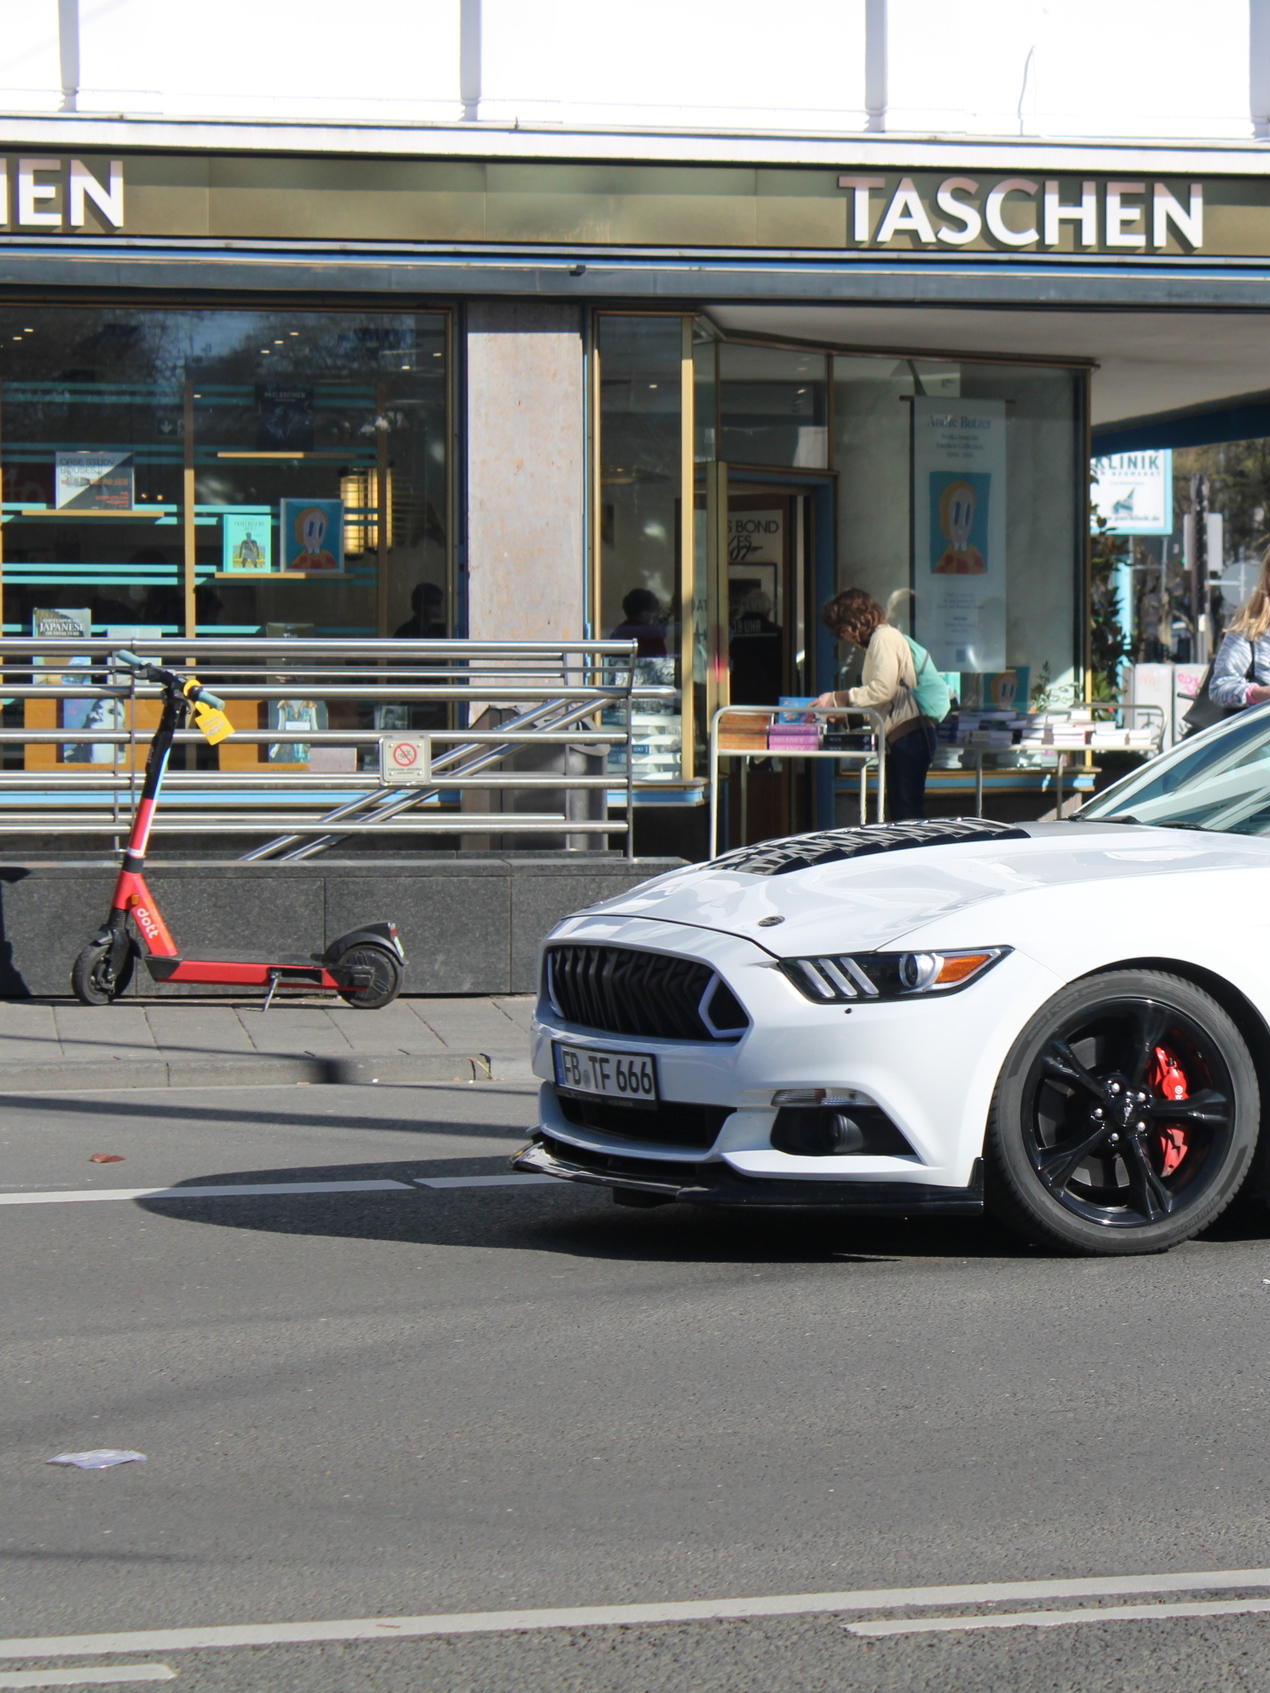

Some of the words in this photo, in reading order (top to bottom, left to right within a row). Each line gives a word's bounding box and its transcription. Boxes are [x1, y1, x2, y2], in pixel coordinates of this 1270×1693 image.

[838, 176, 1203, 248] TASCHEN
[1095, 454, 1160, 470] KLINIK
[736, 519, 779, 534] BOND
[40, 622, 86, 632] JAPANESE
[137, 907, 159, 939] dott
[562, 1050, 582, 1086] FB
[588, 1055, 610, 1090] TF
[616, 1059, 653, 1095] 666
